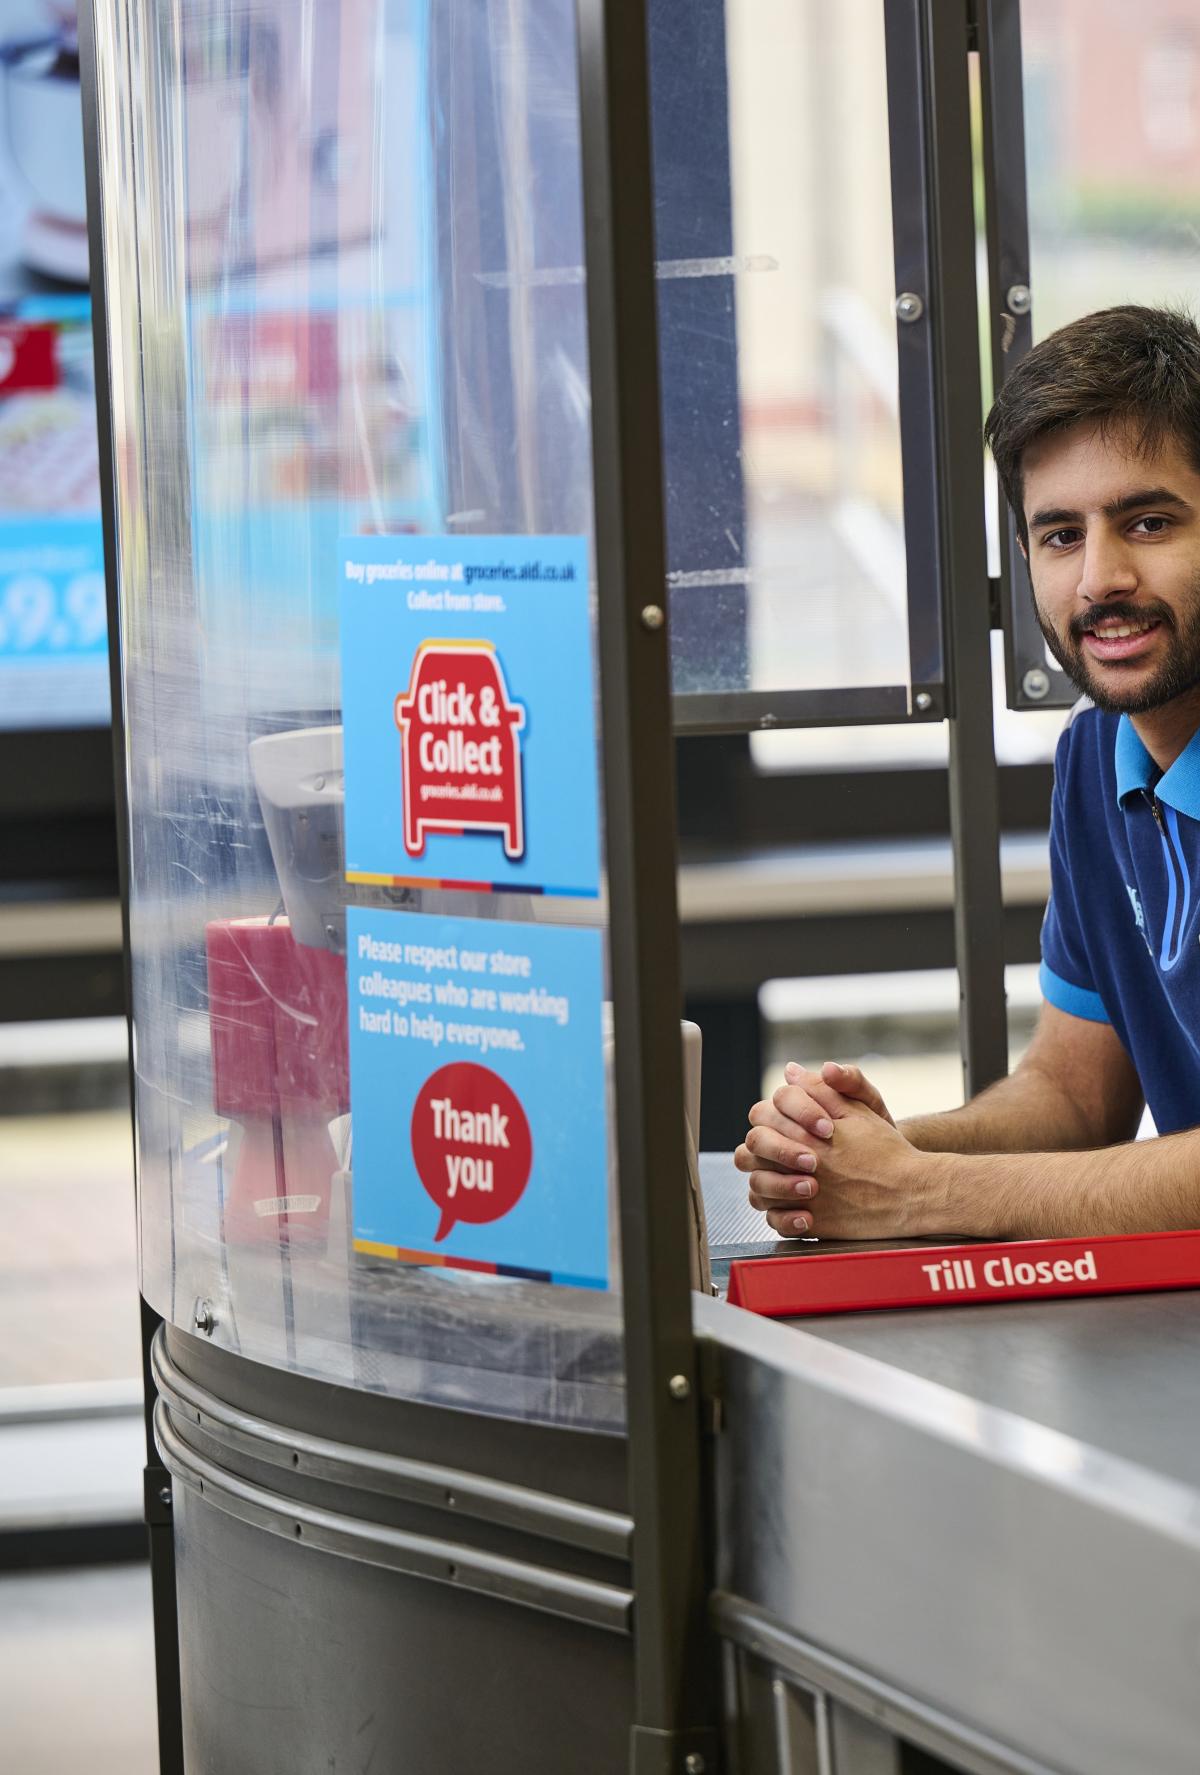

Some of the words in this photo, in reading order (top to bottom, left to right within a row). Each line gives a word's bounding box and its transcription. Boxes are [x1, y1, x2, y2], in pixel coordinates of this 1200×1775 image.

[345, 561, 365, 583] Buy
[366, 561, 413, 584] groceries
[415, 560, 449, 581] online
[451, 563, 463, 581] at
[407, 590, 443, 610] Collect
[443, 590, 472, 610] from
[473, 593, 507, 612] store.
[418, 680, 475, 726] Click
[479, 686, 501, 727] &
[419, 731, 502, 775] Collect
[358, 935, 402, 963] Please
[404, 943, 458, 973] respect
[460, 953, 487, 972] our
[490, 951, 531, 977] store
[359, 971, 432, 1005] colleagues
[435, 980, 468, 1009] who
[470, 991, 497, 1011] are
[500, 987, 569, 1024] working
[360, 1005, 391, 1034] hard
[393, 1013, 409, 1037] to
[410, 1011, 444, 1046] help
[446, 1022, 525, 1054] everyone.
[430, 1097, 510, 1148] Thank
[445, 1154, 494, 1197] you
[922, 1260, 976, 1291] Till
[983, 1250, 1098, 1287] Closed
